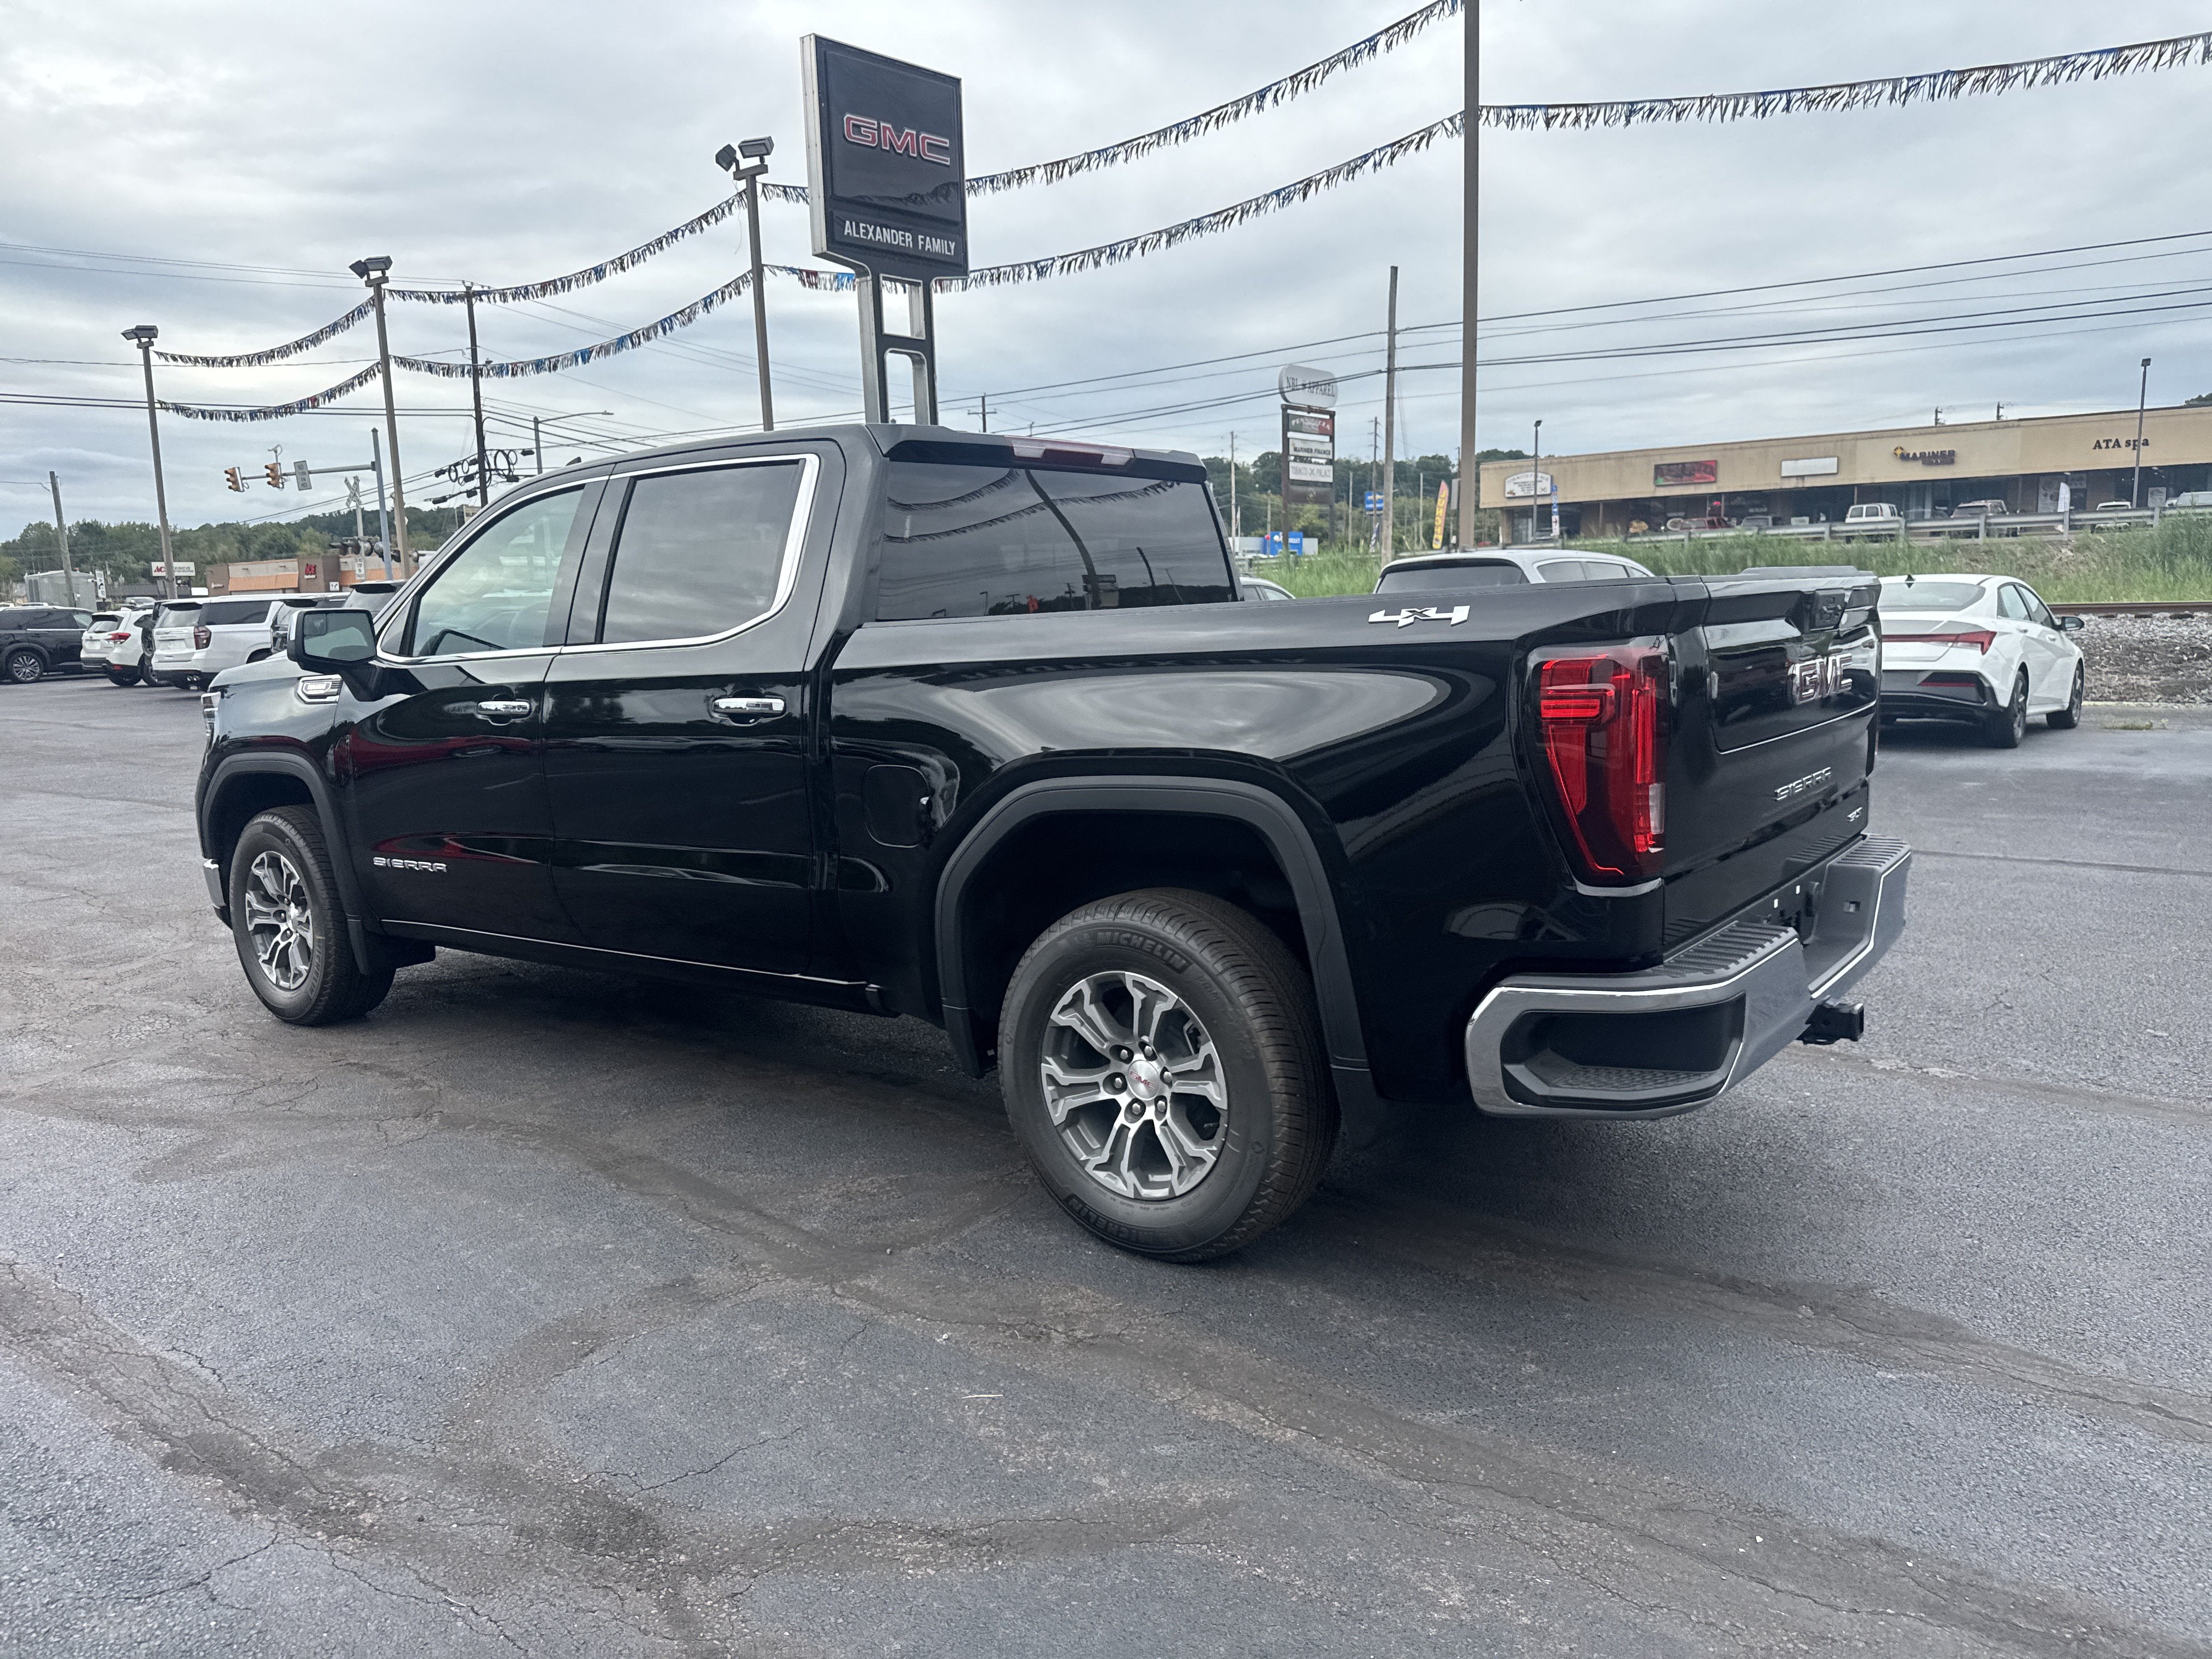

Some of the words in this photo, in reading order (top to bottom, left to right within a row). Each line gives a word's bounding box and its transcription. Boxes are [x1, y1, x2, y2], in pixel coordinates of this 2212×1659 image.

[843, 112, 950, 166] GMC
[844, 220, 913, 249] ALEXANDER
[918, 235, 956, 256] FAMILY
[1900, 450, 1955, 461] MARINER
[2092, 438, 2121, 450] ATA
[2125, 438, 2150, 450] spa
[1792, 653, 1853, 706] GMC
[1774, 766, 1832, 802] SIERRA
[373, 856, 448, 873] SIERRA
[1097, 932, 1188, 971] MICHELIN
[1129, 1070, 1156, 1091] GMC
